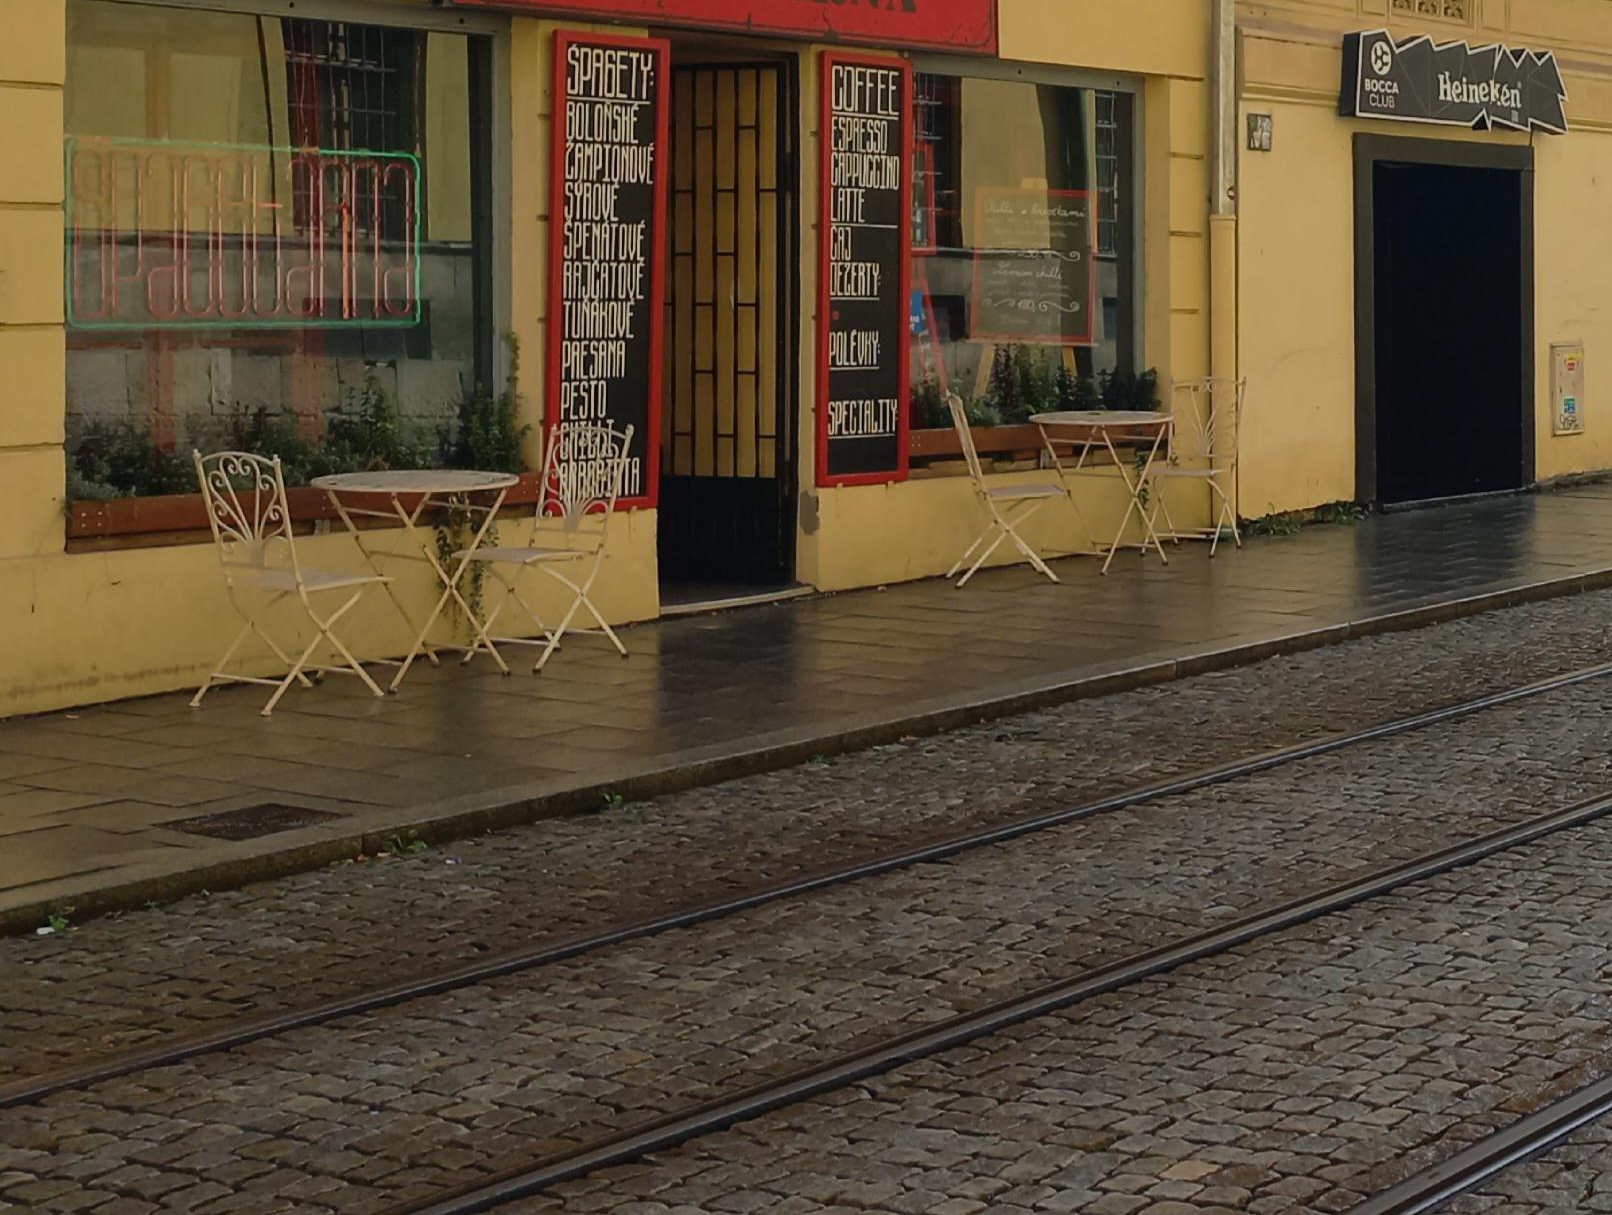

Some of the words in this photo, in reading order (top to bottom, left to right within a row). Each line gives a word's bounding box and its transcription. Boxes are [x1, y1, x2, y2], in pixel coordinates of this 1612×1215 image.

[832, 65, 899, 116] COFFEE
[1365, 78, 1399, 94] BOCCA
[1369, 93, 1395, 108] CLUB
[1438, 71, 1522, 108] Heineken
[566, 100, 639, 144] BOLOŇSKÉ
[831, 117, 888, 154] ESPRESSO
[565, 139, 654, 185] ŽAMPIONOVÉ
[831, 152, 900, 190] CAPPUCCINO
[830, 187, 866, 223] LATTE
[563, 219, 646, 261] ŠPENÁTOVÉ
[562, 259, 645, 300] RAJČATOVÉ
[561, 340, 626, 380] PAESANA
[560, 380, 607, 421] PESTO
